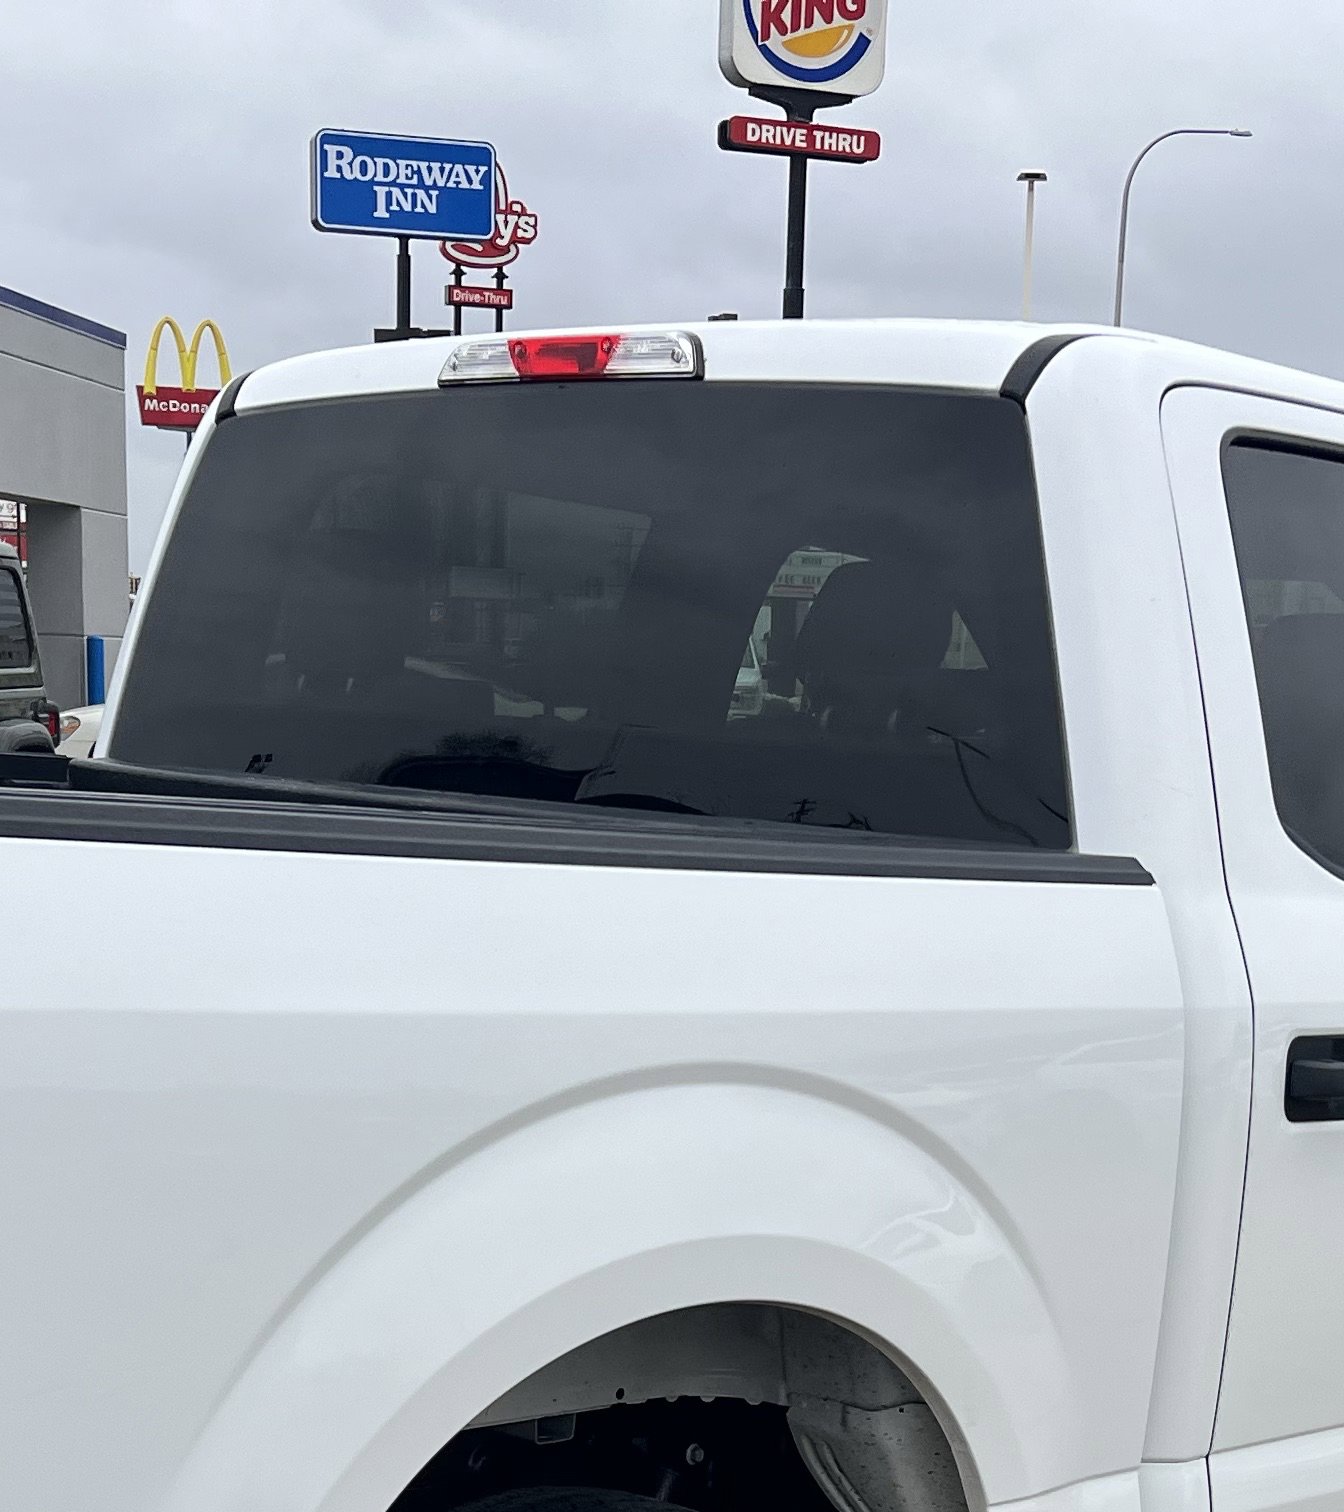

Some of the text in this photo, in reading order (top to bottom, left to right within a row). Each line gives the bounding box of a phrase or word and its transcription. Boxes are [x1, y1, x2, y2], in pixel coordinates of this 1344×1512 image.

[746, 122, 865, 154] DRIVE THRU
[323, 143, 488, 191] RODEWAY
[372, 185, 439, 219] INN
[452, 289, 509, 306] Drive-Thru
[144, 398, 210, 414] McDona
